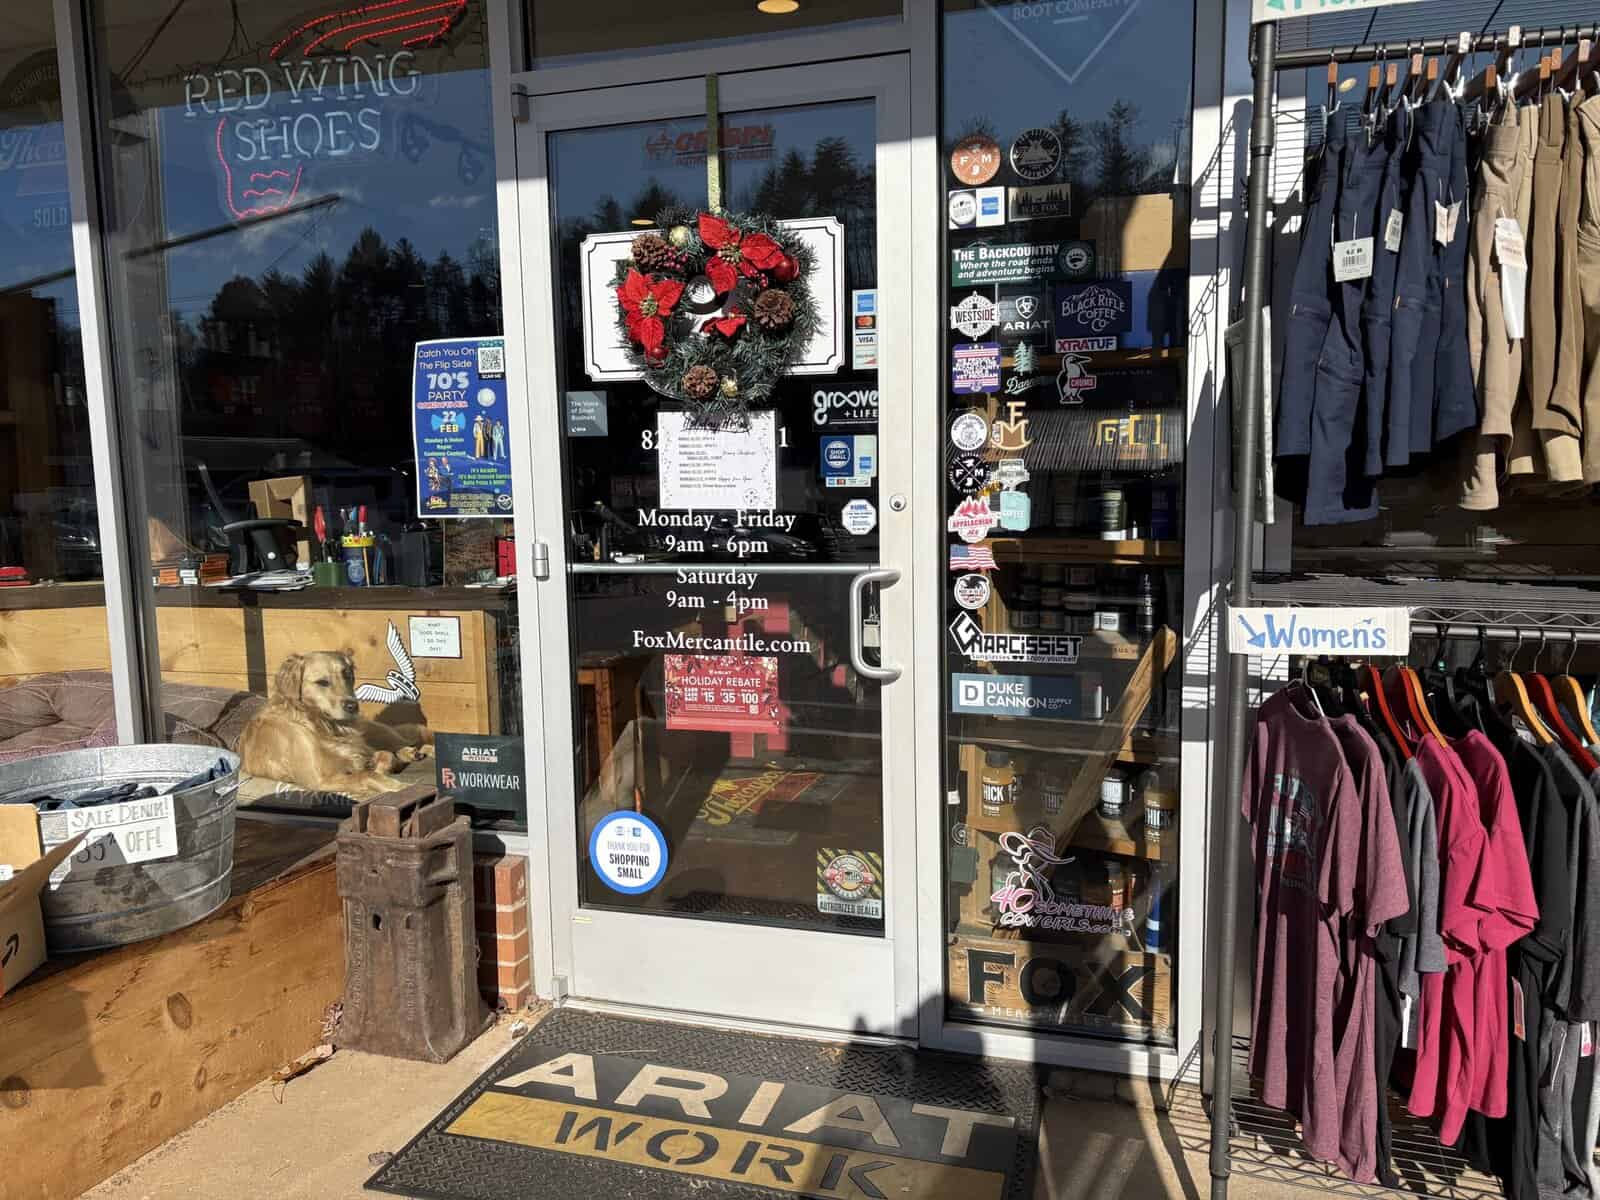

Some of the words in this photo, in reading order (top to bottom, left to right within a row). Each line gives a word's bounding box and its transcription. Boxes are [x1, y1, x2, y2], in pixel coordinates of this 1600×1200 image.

[183, 70, 272, 117] RED
[281, 50, 421, 104] WING
[234, 108, 381, 162] SHOES
[954, 249, 975, 261] THE
[979, 244, 1060, 260] BACKCOUNTRY
[960, 261, 990, 271] Where
[992, 260, 1006, 268] the
[1008, 258, 1029, 267] road
[1031, 256, 1053, 265] ends
[958, 270, 974, 280] and
[975, 267, 1023, 279] adventure
[1024, 265, 1056, 277] begins
[1062, 295, 1096, 317] BLACK
[1097, 294, 1126, 313] RIFLE
[955, 308, 995, 324] WESTSIDE
[1077, 307, 1117, 325] COFFEE
[1003, 320, 1050, 332] ARIAT
[418, 349, 441, 359] Catch
[443, 348, 460, 357] You
[461, 347, 475, 356] On
[1057, 338, 1114, 351] XTRATUF
[420, 361, 434, 370] The
[434, 360, 450, 369] Flip
[451, 359, 473, 369] Side
[426, 371, 470, 390] 70'S
[428, 390, 467, 401] PARTY
[441, 411, 457, 423] 22
[440, 424, 459, 433] FEB
[637, 508, 714, 531] Monday
[734, 509, 796, 532] Friday
[665, 535, 704, 553] 9am
[726, 535, 769, 558] 6pm
[676, 567, 758, 590] Saturday
[666, 590, 705, 609] 9am
[726, 590, 769, 614] 4pm
[632, 630, 812, 653] FoxMercantile.com
[681, 675, 723, 687] HOLIDAY
[726, 677, 761, 688] REBATE
[986, 682, 1024, 694] DUKE
[986, 695, 1048, 710] CANNON
[1047, 697, 1073, 705] SUPPLY
[462, 747, 499, 756] ARIAT
[459, 771, 521, 790] WORKWEAR
[71, 810, 116, 829] SALE
[119, 800, 169, 824] DENIM!
[125, 827, 162, 853] OFF!
[609, 853, 650, 867] SHOPPING
[617, 867, 644, 880] SMALL
[991, 887, 1039, 914] 40
[967, 949, 1152, 1021] FOX
[495, 1053, 1017, 1159] ARIAT
[554, 1111, 900, 1200] WORK
